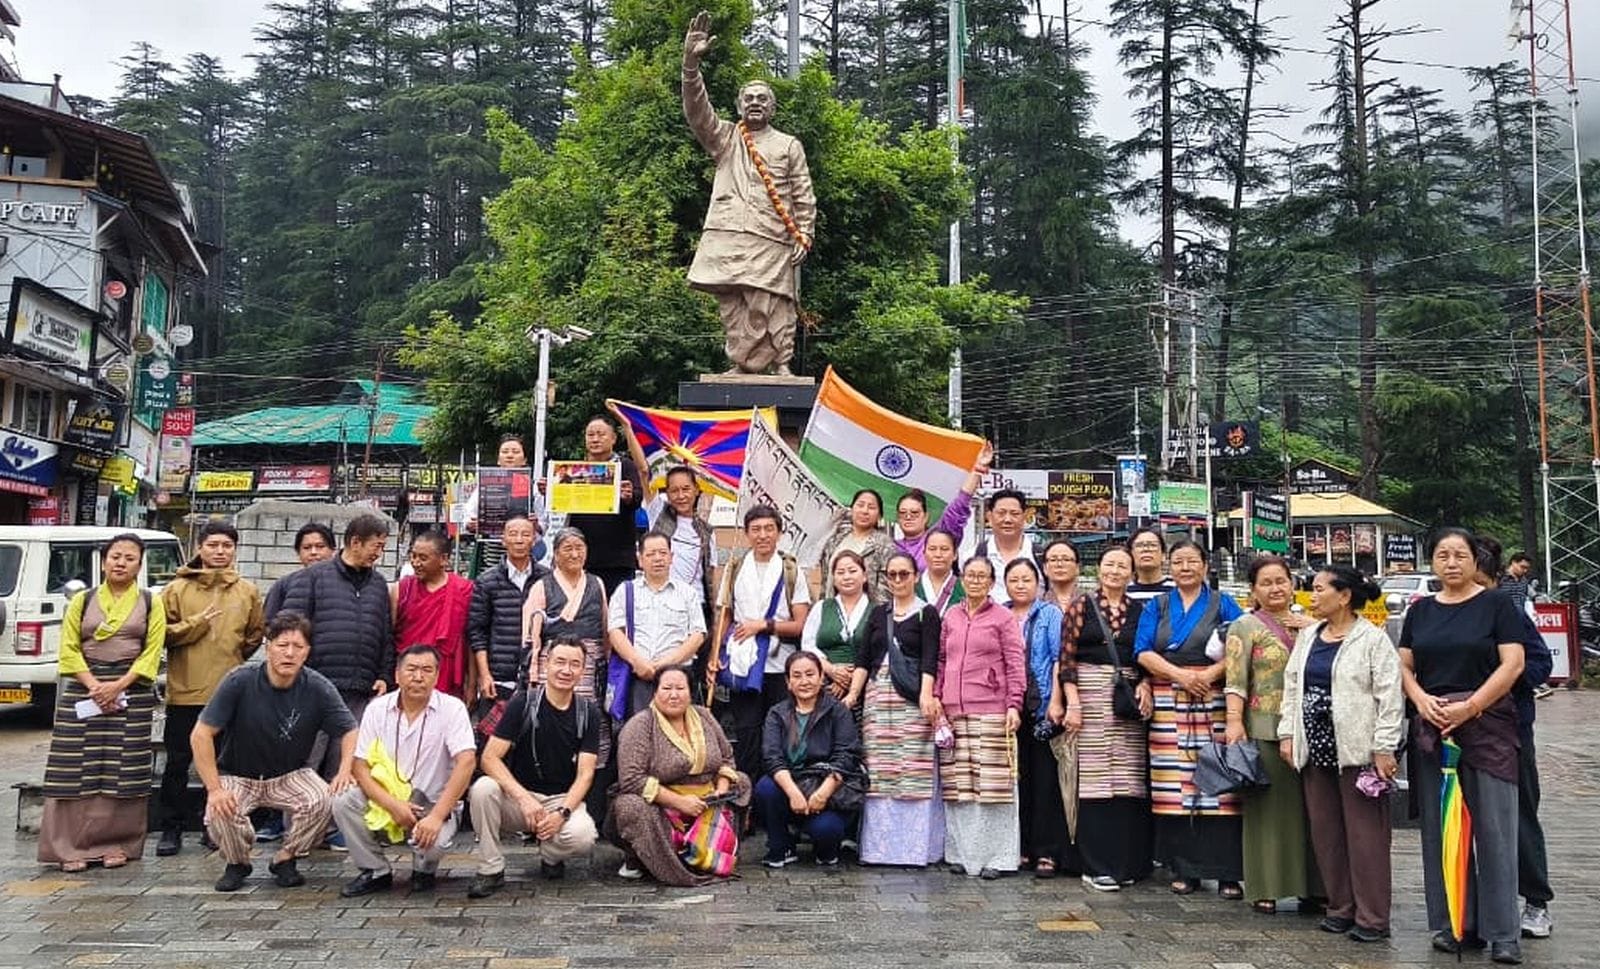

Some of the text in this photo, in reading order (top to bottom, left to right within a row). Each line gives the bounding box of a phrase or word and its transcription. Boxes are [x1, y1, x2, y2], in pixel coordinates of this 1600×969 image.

[18, 203, 77, 222] CAFE
[1064, 473, 1094, 483] FRESH
[1050, 484, 1111, 494] DOUGH PIZZA
[1387, 551, 1415, 560] Dough
